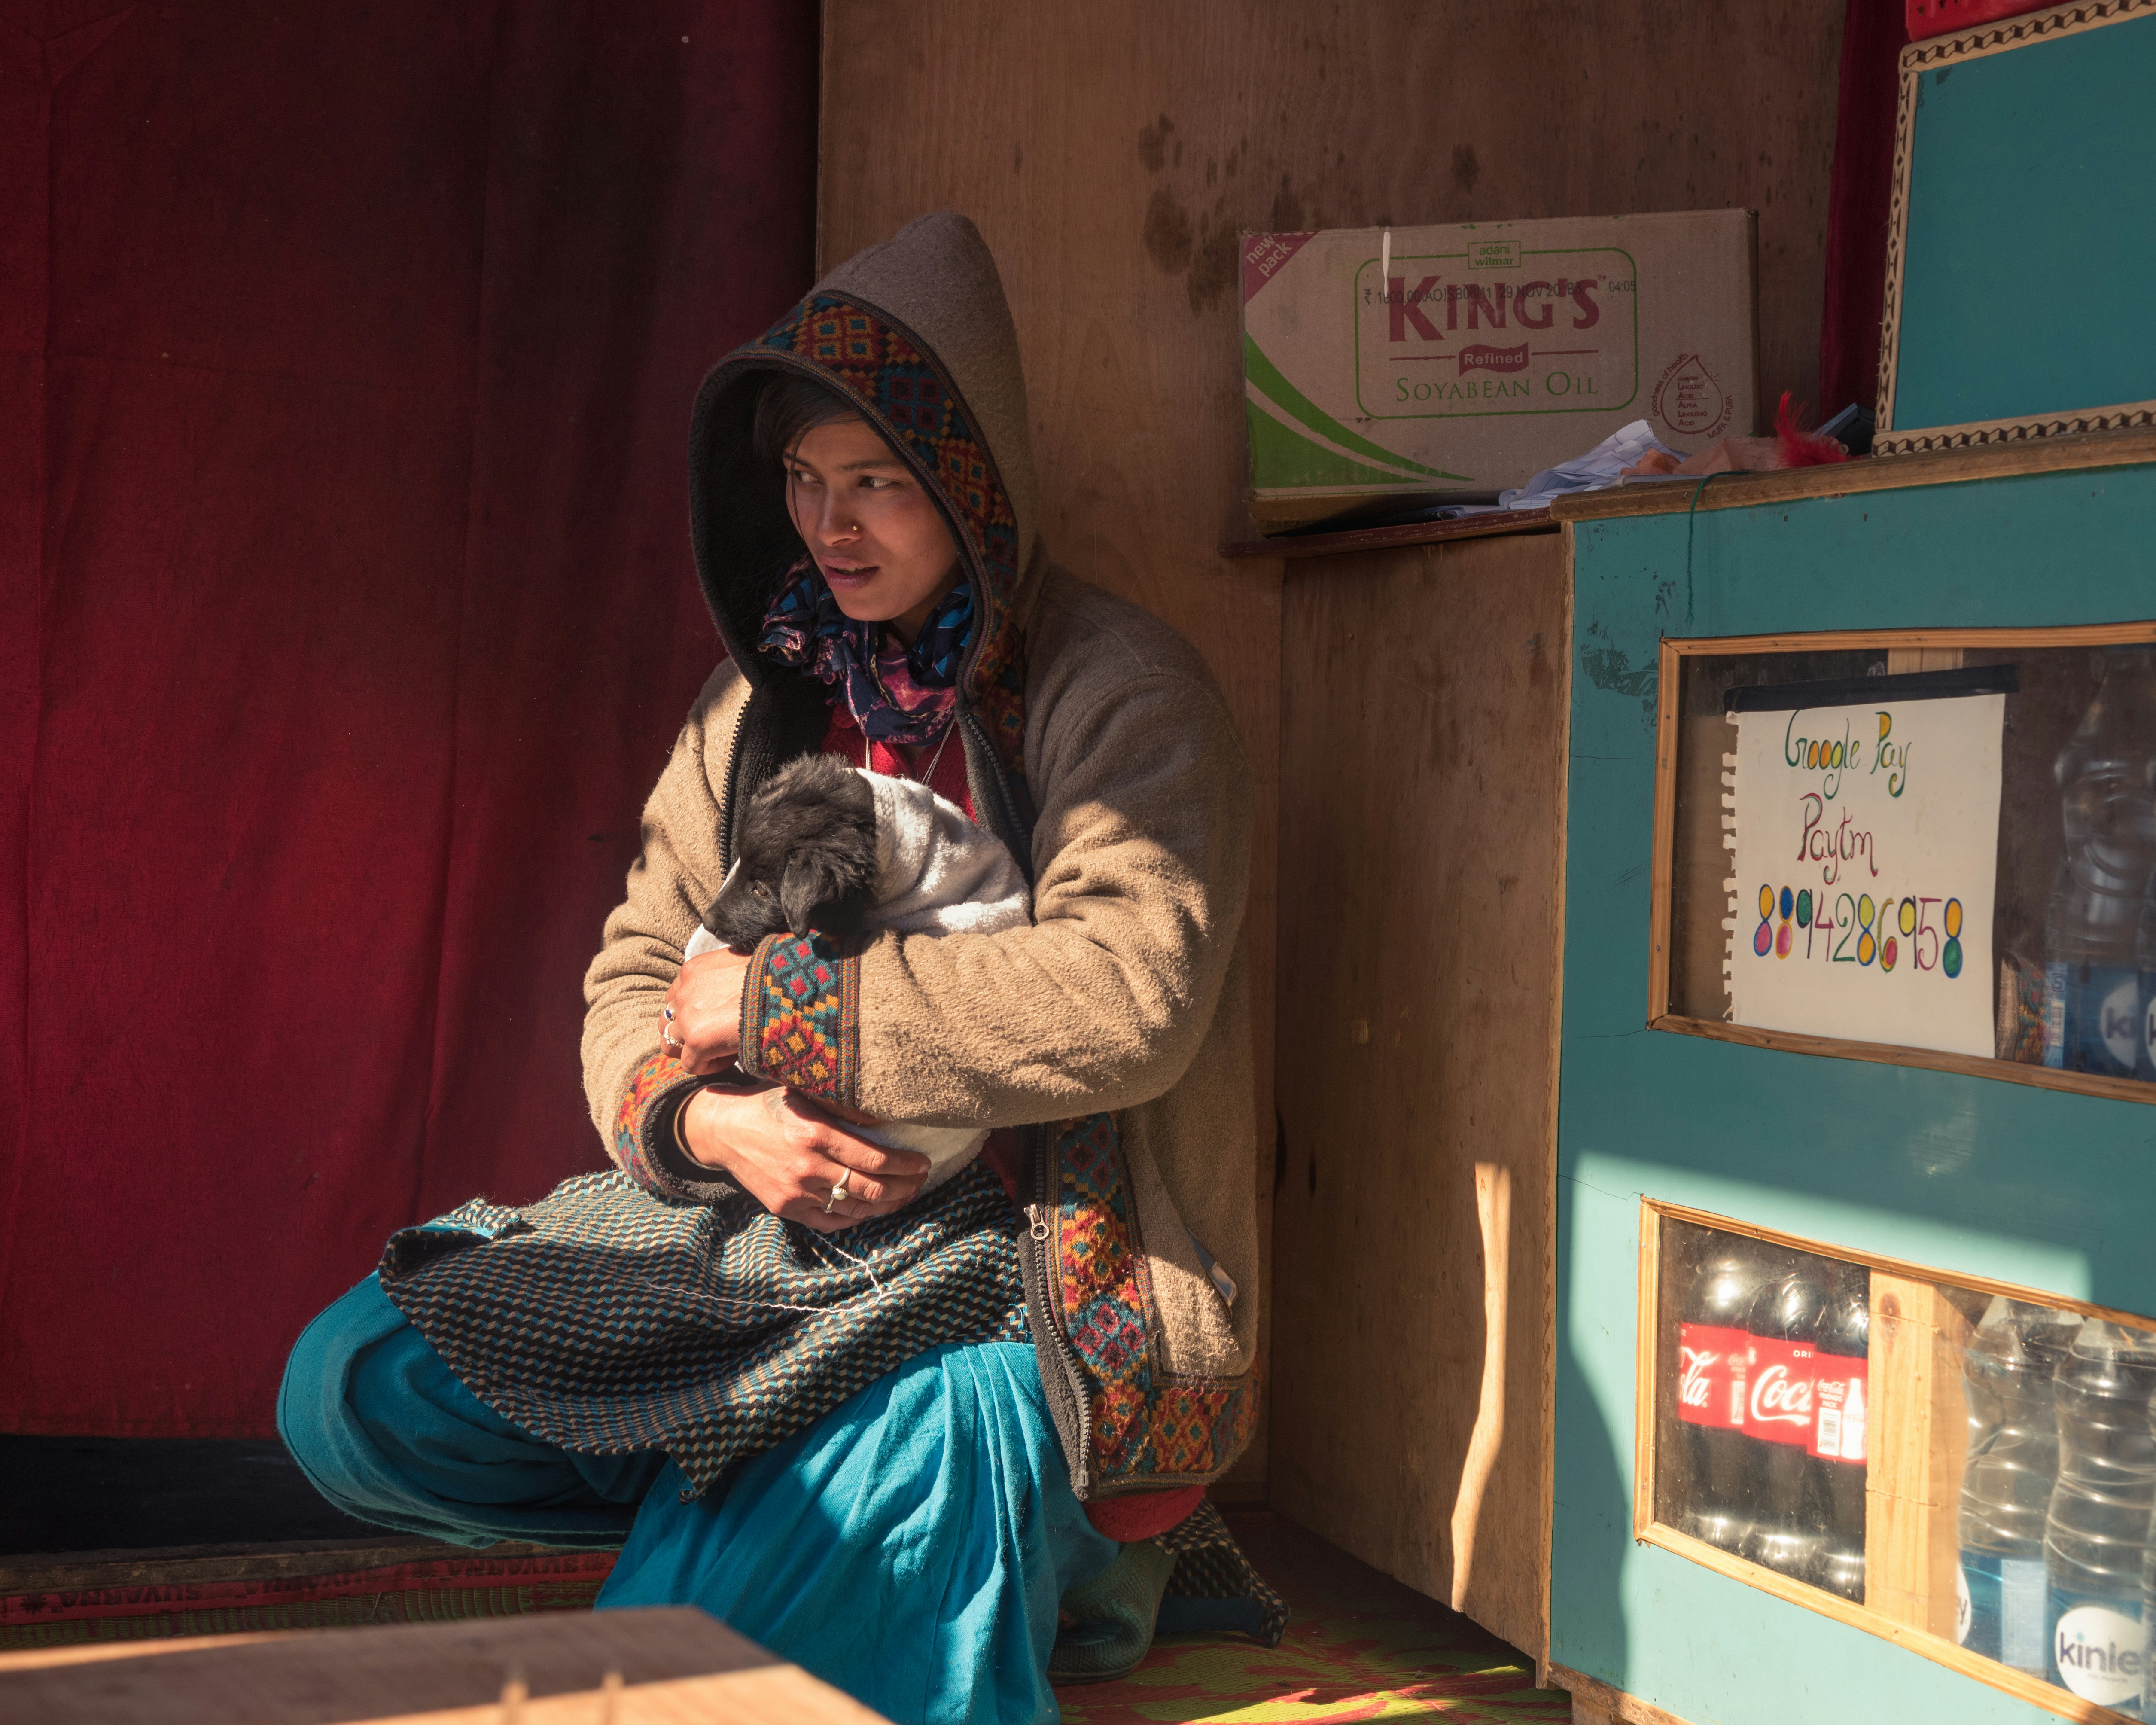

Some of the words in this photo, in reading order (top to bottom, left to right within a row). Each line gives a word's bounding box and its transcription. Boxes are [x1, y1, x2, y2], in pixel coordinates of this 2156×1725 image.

[1246, 235, 1275, 264] new
[1258, 242, 1292, 277] pack
[1475, 257, 1514, 266] wilmar
[1479, 244, 1510, 255] adani
[1499, 285, 1513, 299] 29
[1517, 284, 1543, 297] NOV
[1547, 283, 1561, 297] 20
[1609, 280, 1636, 292] 04:05
[1388, 276, 1599, 342] KING'S
[1464, 352, 1523, 366] Refined
[1666, 354, 1689, 372] health
[1396, 377, 1530, 402] SOYABEAN
[1547, 371, 1599, 396] OIL
[1663, 370, 1670, 380] of
[1651, 380, 1664, 417] goodness
[1707, 423, 1728, 439] MUFA
[1725, 395, 1733, 415] PUFA
[1784, 709, 1860, 800] Google
[1870, 711, 1912, 798] Pay
[1797, 792, 1878, 885] Paytm
[1754, 884, 1963, 979] 8894286958
[1793, 1350, 1814, 1359] ORI
[1819, 1393, 1842, 1402] FRIENDS
[1822, 1401, 1837, 1409] PACK
[2059, 1631, 2143, 1676] kinle
